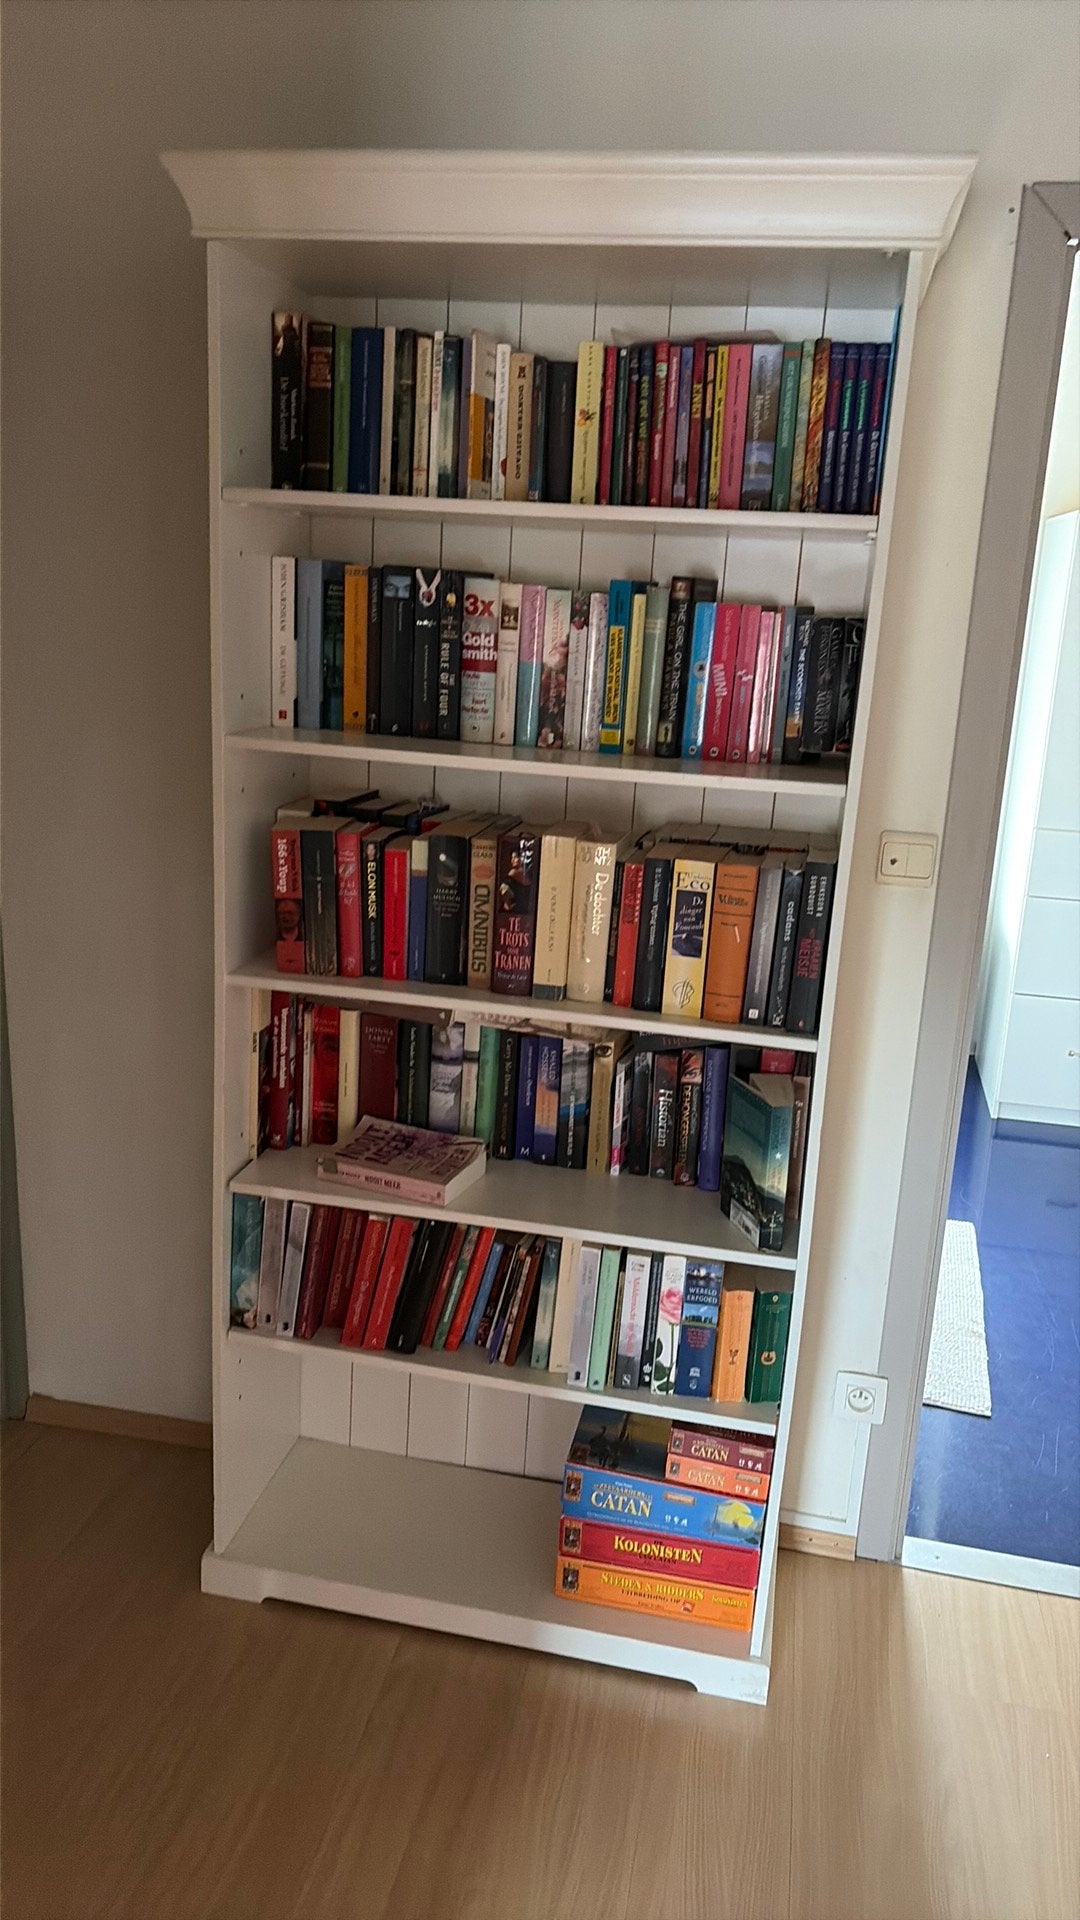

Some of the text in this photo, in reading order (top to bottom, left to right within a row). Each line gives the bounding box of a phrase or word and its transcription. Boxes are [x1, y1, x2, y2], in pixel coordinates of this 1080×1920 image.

[465, 594, 496, 617] 3x
[463, 631, 495, 647] Gold
[462, 646, 498, 661] smith
[668, 603, 687, 721] THE GIRL ON THE TRAIN
[438, 642, 450, 716] RULE OF FOUR
[367, 861, 377, 920] ELON MUSK
[677, 872, 711, 891] Eco
[591, 871, 609, 937] De dochter
[472, 884, 491, 975] OMNIBUS
[509, 916, 521, 931] TE
[783, 901, 795, 942] cadans
[500, 928, 529, 947] TROTS
[495, 950, 532, 971] TRANEN
[657, 1089, 673, 1147] Historian
[687, 1294, 718, 1305] ERFGOED
[689, 1286, 718, 1297] WERELD
[691, 1444, 729, 1463] CATAN
[688, 1469, 726, 1488] CATAN
[591, 1490, 653, 1518] CATAN
[614, 1535, 704, 1565] KOLONISTEN
[600, 1573, 705, 1602] STEDEN & RIDDERS
